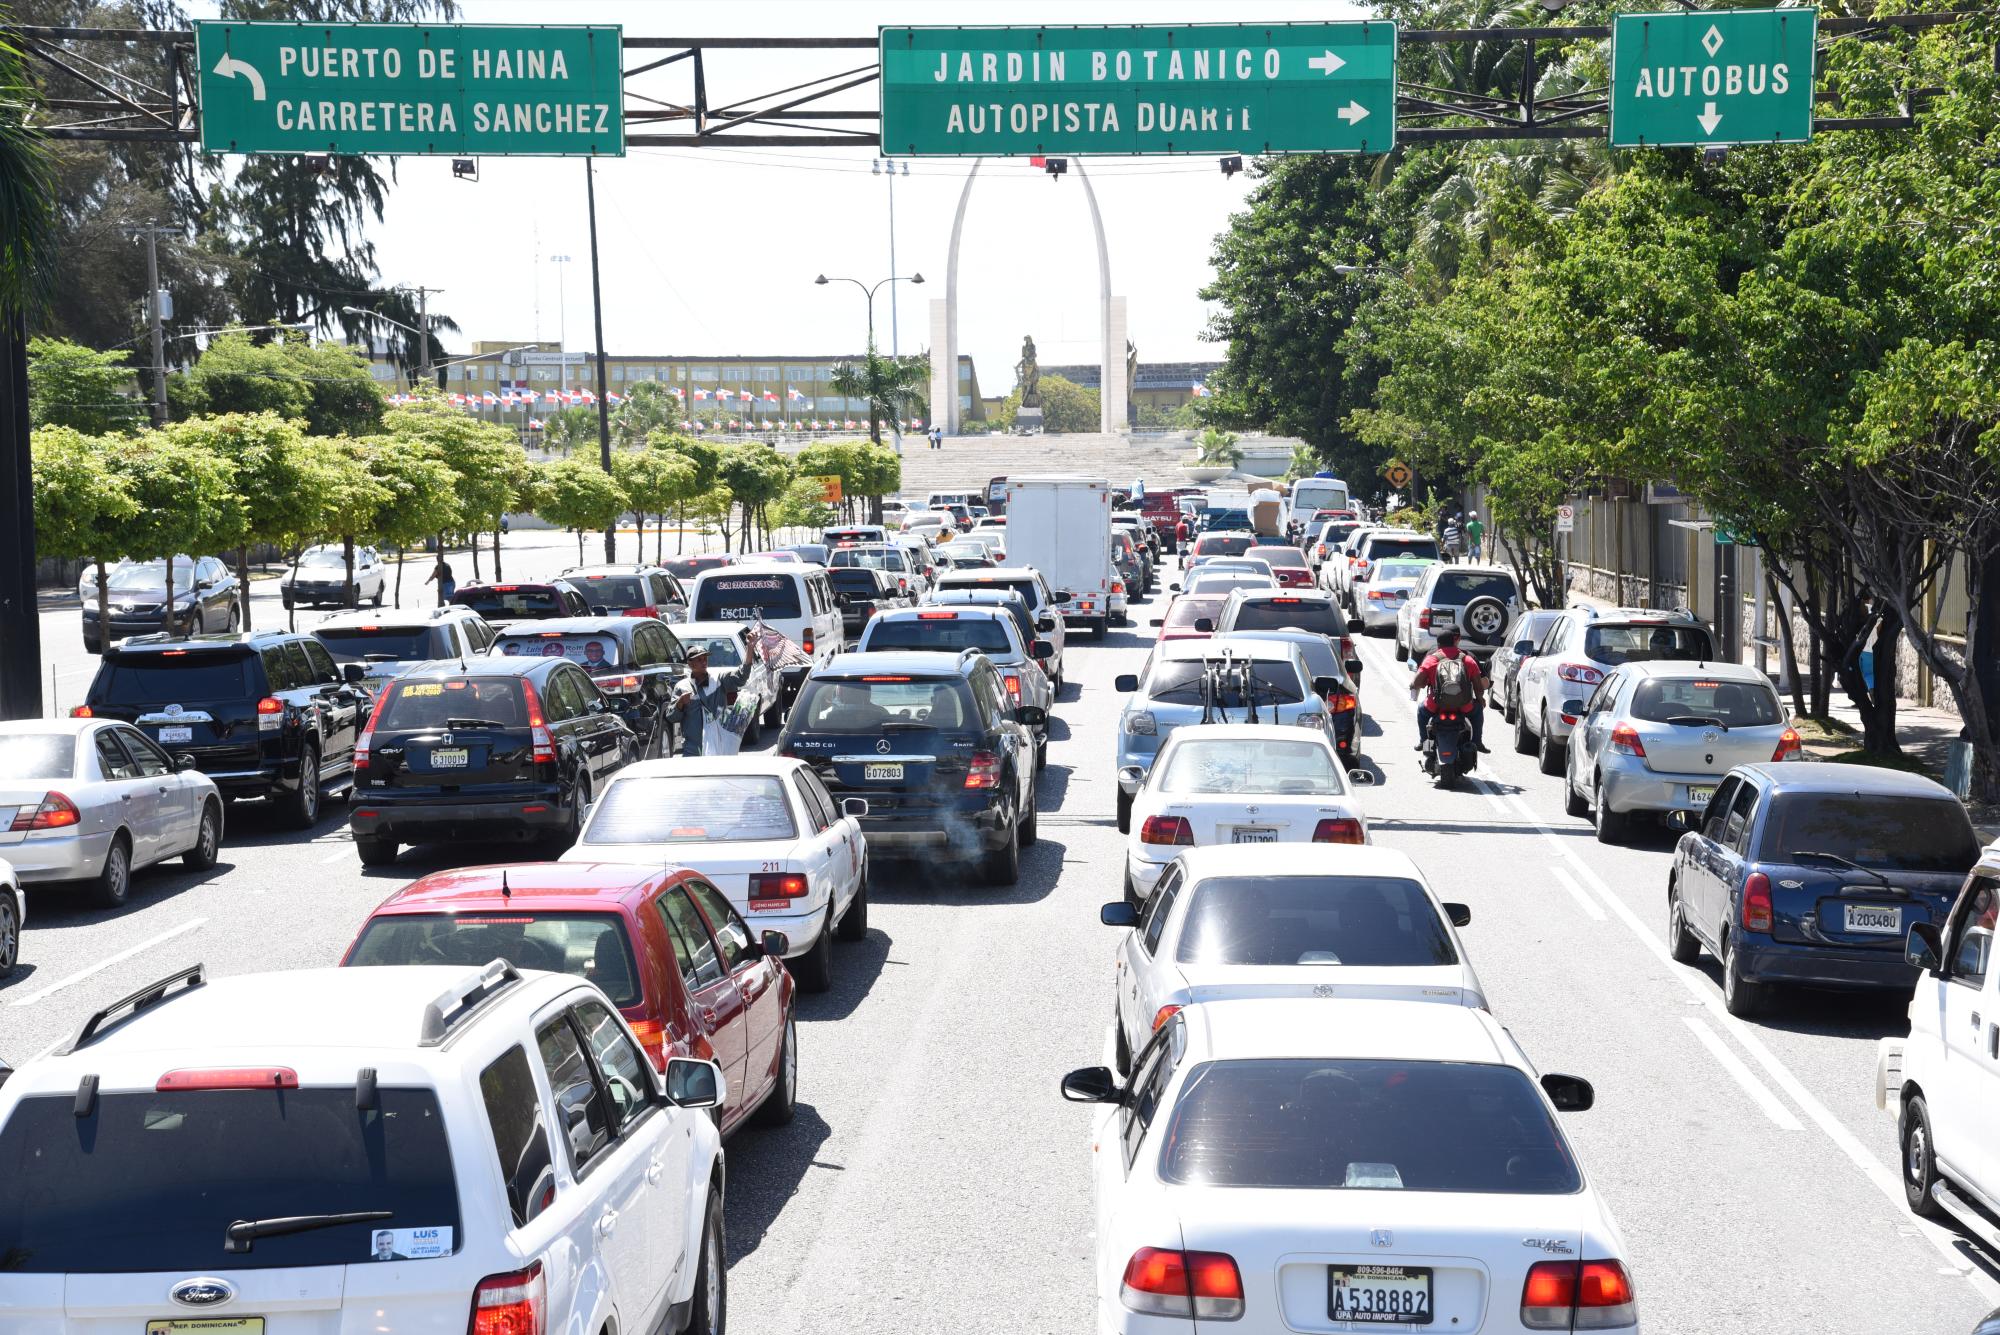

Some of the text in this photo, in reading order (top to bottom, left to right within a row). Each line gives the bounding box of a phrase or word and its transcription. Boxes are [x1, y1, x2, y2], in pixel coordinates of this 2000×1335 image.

[280, 46, 569, 80] PUERTO DE HAINA
[934, 48, 1281, 82] JARDIN BOTANICO
[1634, 63, 1789, 98] AUTOBUS
[276, 100, 609, 133] CARRETERA SANCHEZ
[947, 102, 1120, 134] AUTOPISTA
[433, 755, 466, 765] G310019
[866, 768, 901, 778] G072803
[1691, 792, 1712, 801] A624
[762, 862, 779, 871] 211
[1848, 913, 1896, 927] A203480
[185, 1284, 217, 1301] Ford
[1334, 1287, 1427, 1313] A538882
[1335, 1311, 1396, 1321] UPA AUTO IMPORT
[173, 1321, 238, 1330] REP. DOMINICANA
